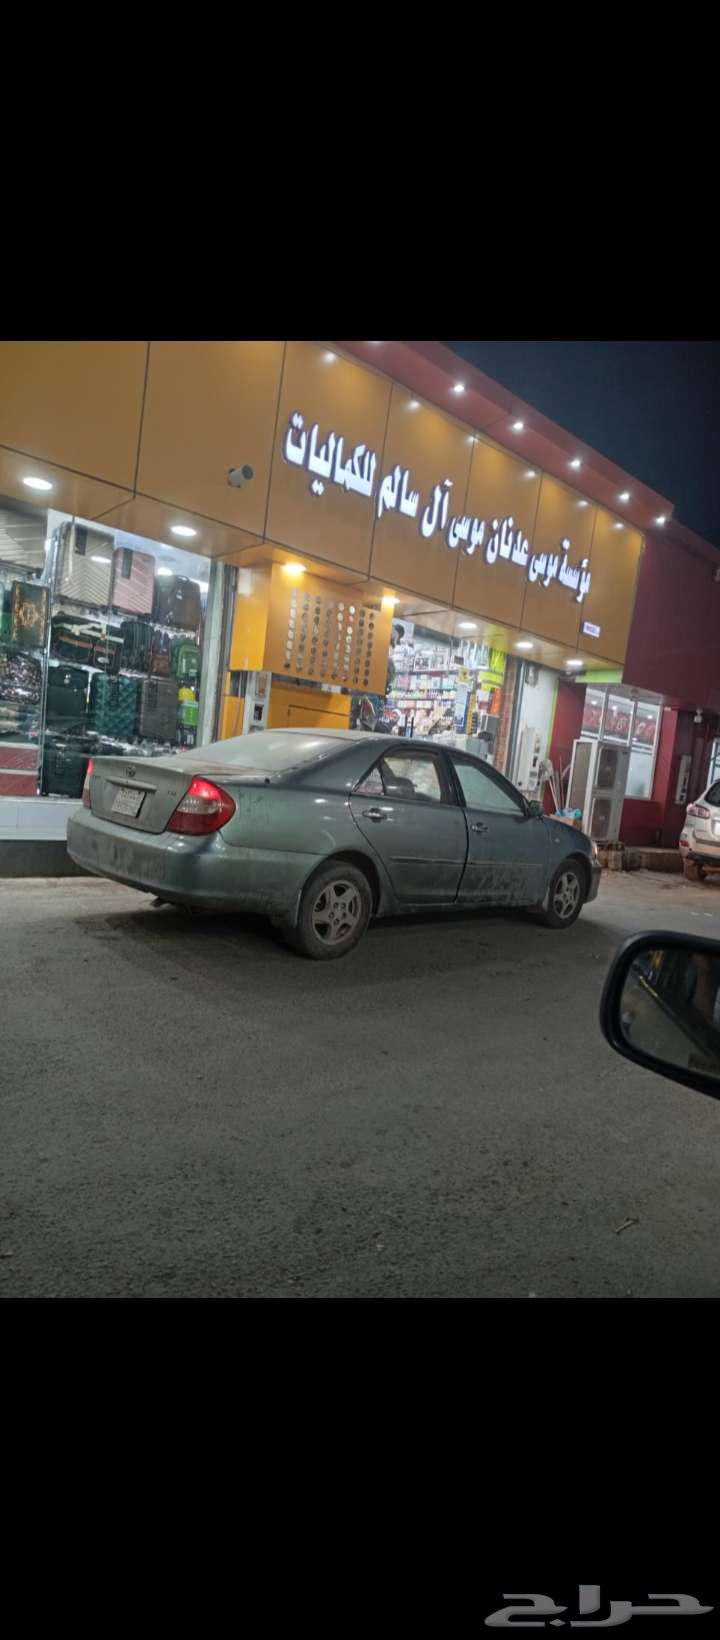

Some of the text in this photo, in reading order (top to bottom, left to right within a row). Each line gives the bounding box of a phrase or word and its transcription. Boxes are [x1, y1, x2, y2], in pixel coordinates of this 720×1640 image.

[285, 412, 377, 497] للكماليات
[377, 464, 420, 518] سالم
[421, 478, 454, 538] آل
[486, 516, 530, 566] عدنان
[557, 538, 592, 604] مؤسسة
